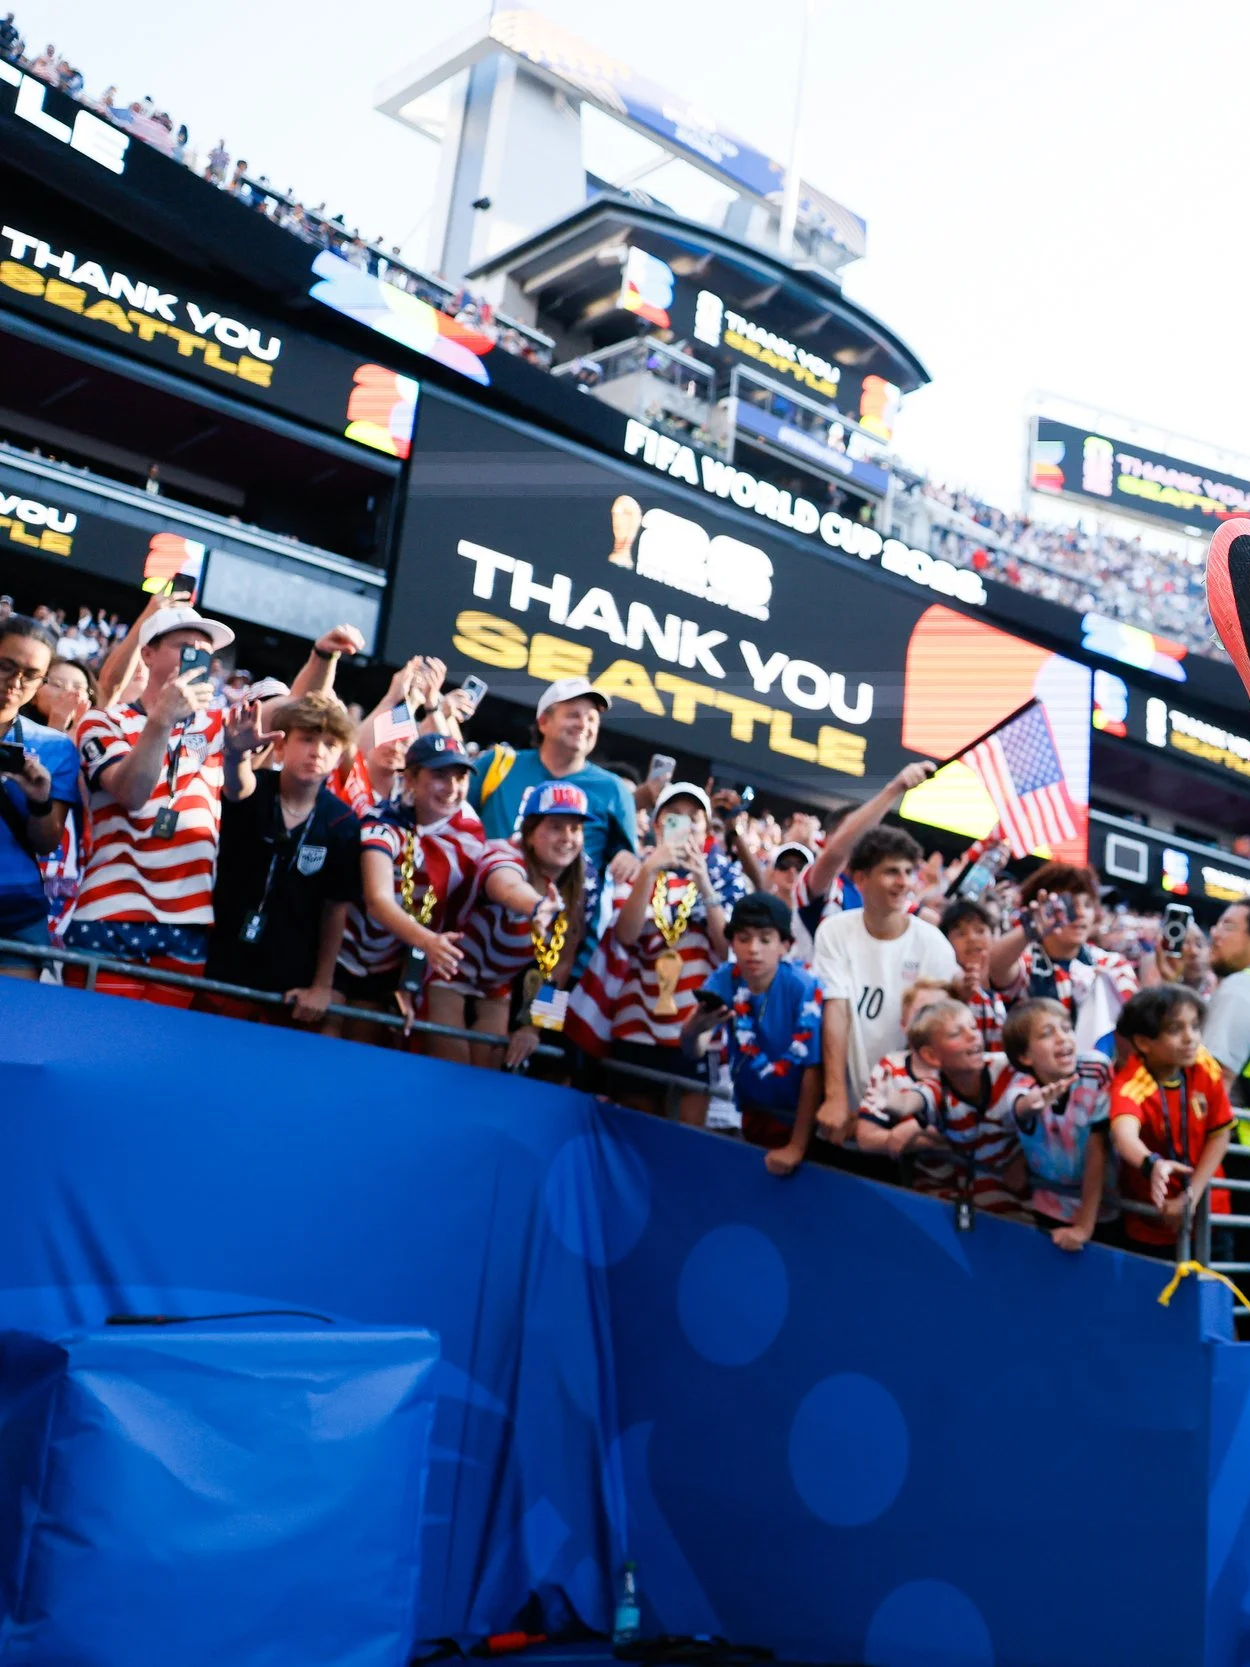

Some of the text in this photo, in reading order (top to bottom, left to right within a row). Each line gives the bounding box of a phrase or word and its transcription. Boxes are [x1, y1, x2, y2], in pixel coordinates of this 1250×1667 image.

[0, 58, 130, 175] LE
[0, 260, 273, 389] SEATTLE
[1, 225, 281, 361] THANK YOU
[624, 418, 699, 486] FIFA
[701, 455, 820, 534] WORLD
[820, 511, 883, 560] CUP
[452, 610, 867, 777] SEATTLE
[457, 539, 728, 679] THANK
[739, 640, 874, 725] YOU
[553, 786, 583, 810] USA
[857, 986, 884, 1020] 10
